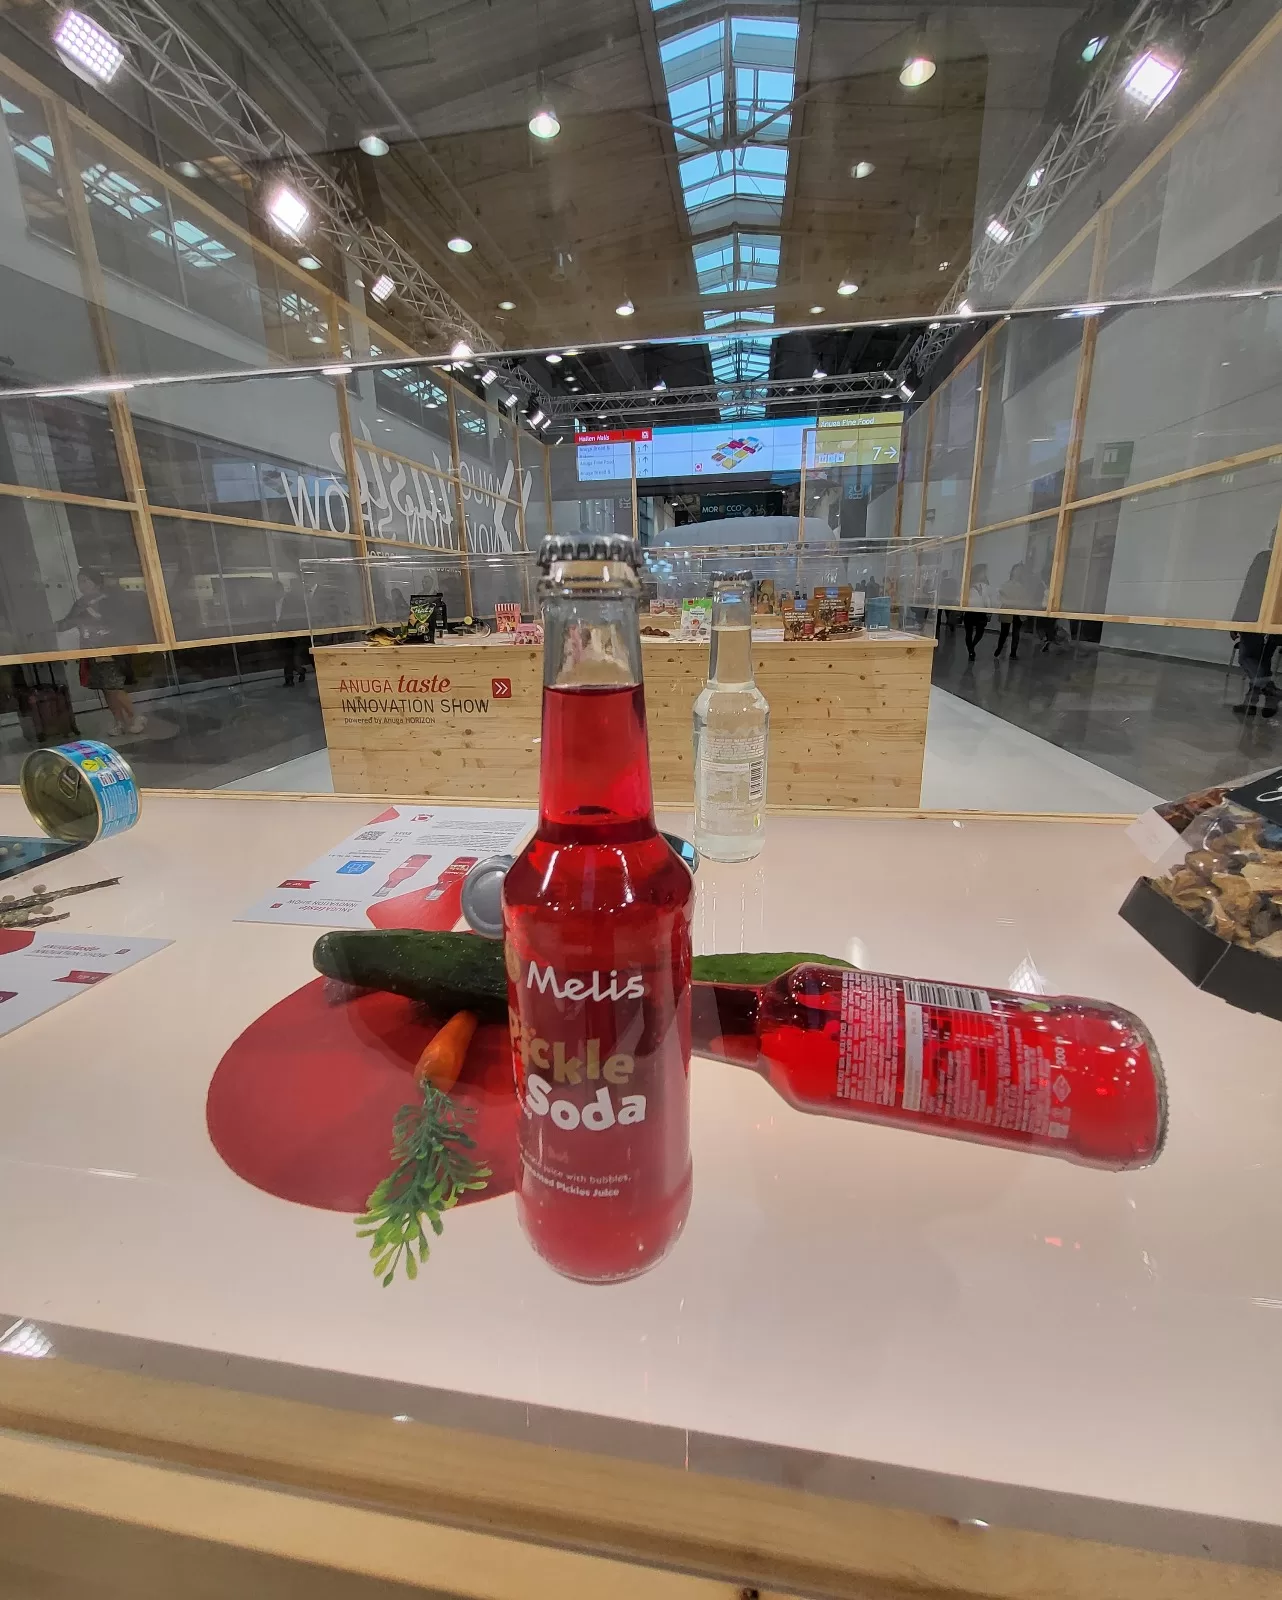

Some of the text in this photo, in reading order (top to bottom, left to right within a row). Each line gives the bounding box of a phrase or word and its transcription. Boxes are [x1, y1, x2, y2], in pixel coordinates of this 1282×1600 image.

[858, 417, 875, 425] Food
[597, 433, 610, 441] Halls
[873, 446, 882, 461] 7
[340, 674, 452, 694] ANUGA taste
[341, 698, 490, 714] INNOVATION SHOW
[374, 717, 382, 725] by
[383, 717, 404, 726] Anuga
[526, 960, 646, 1002] Melis
[526, 1073, 647, 1131] Soda
[566, 1173, 587, 1183] with
[556, 1180, 591, 1197] Pickles
[592, 1188, 620, 1198] Juice
